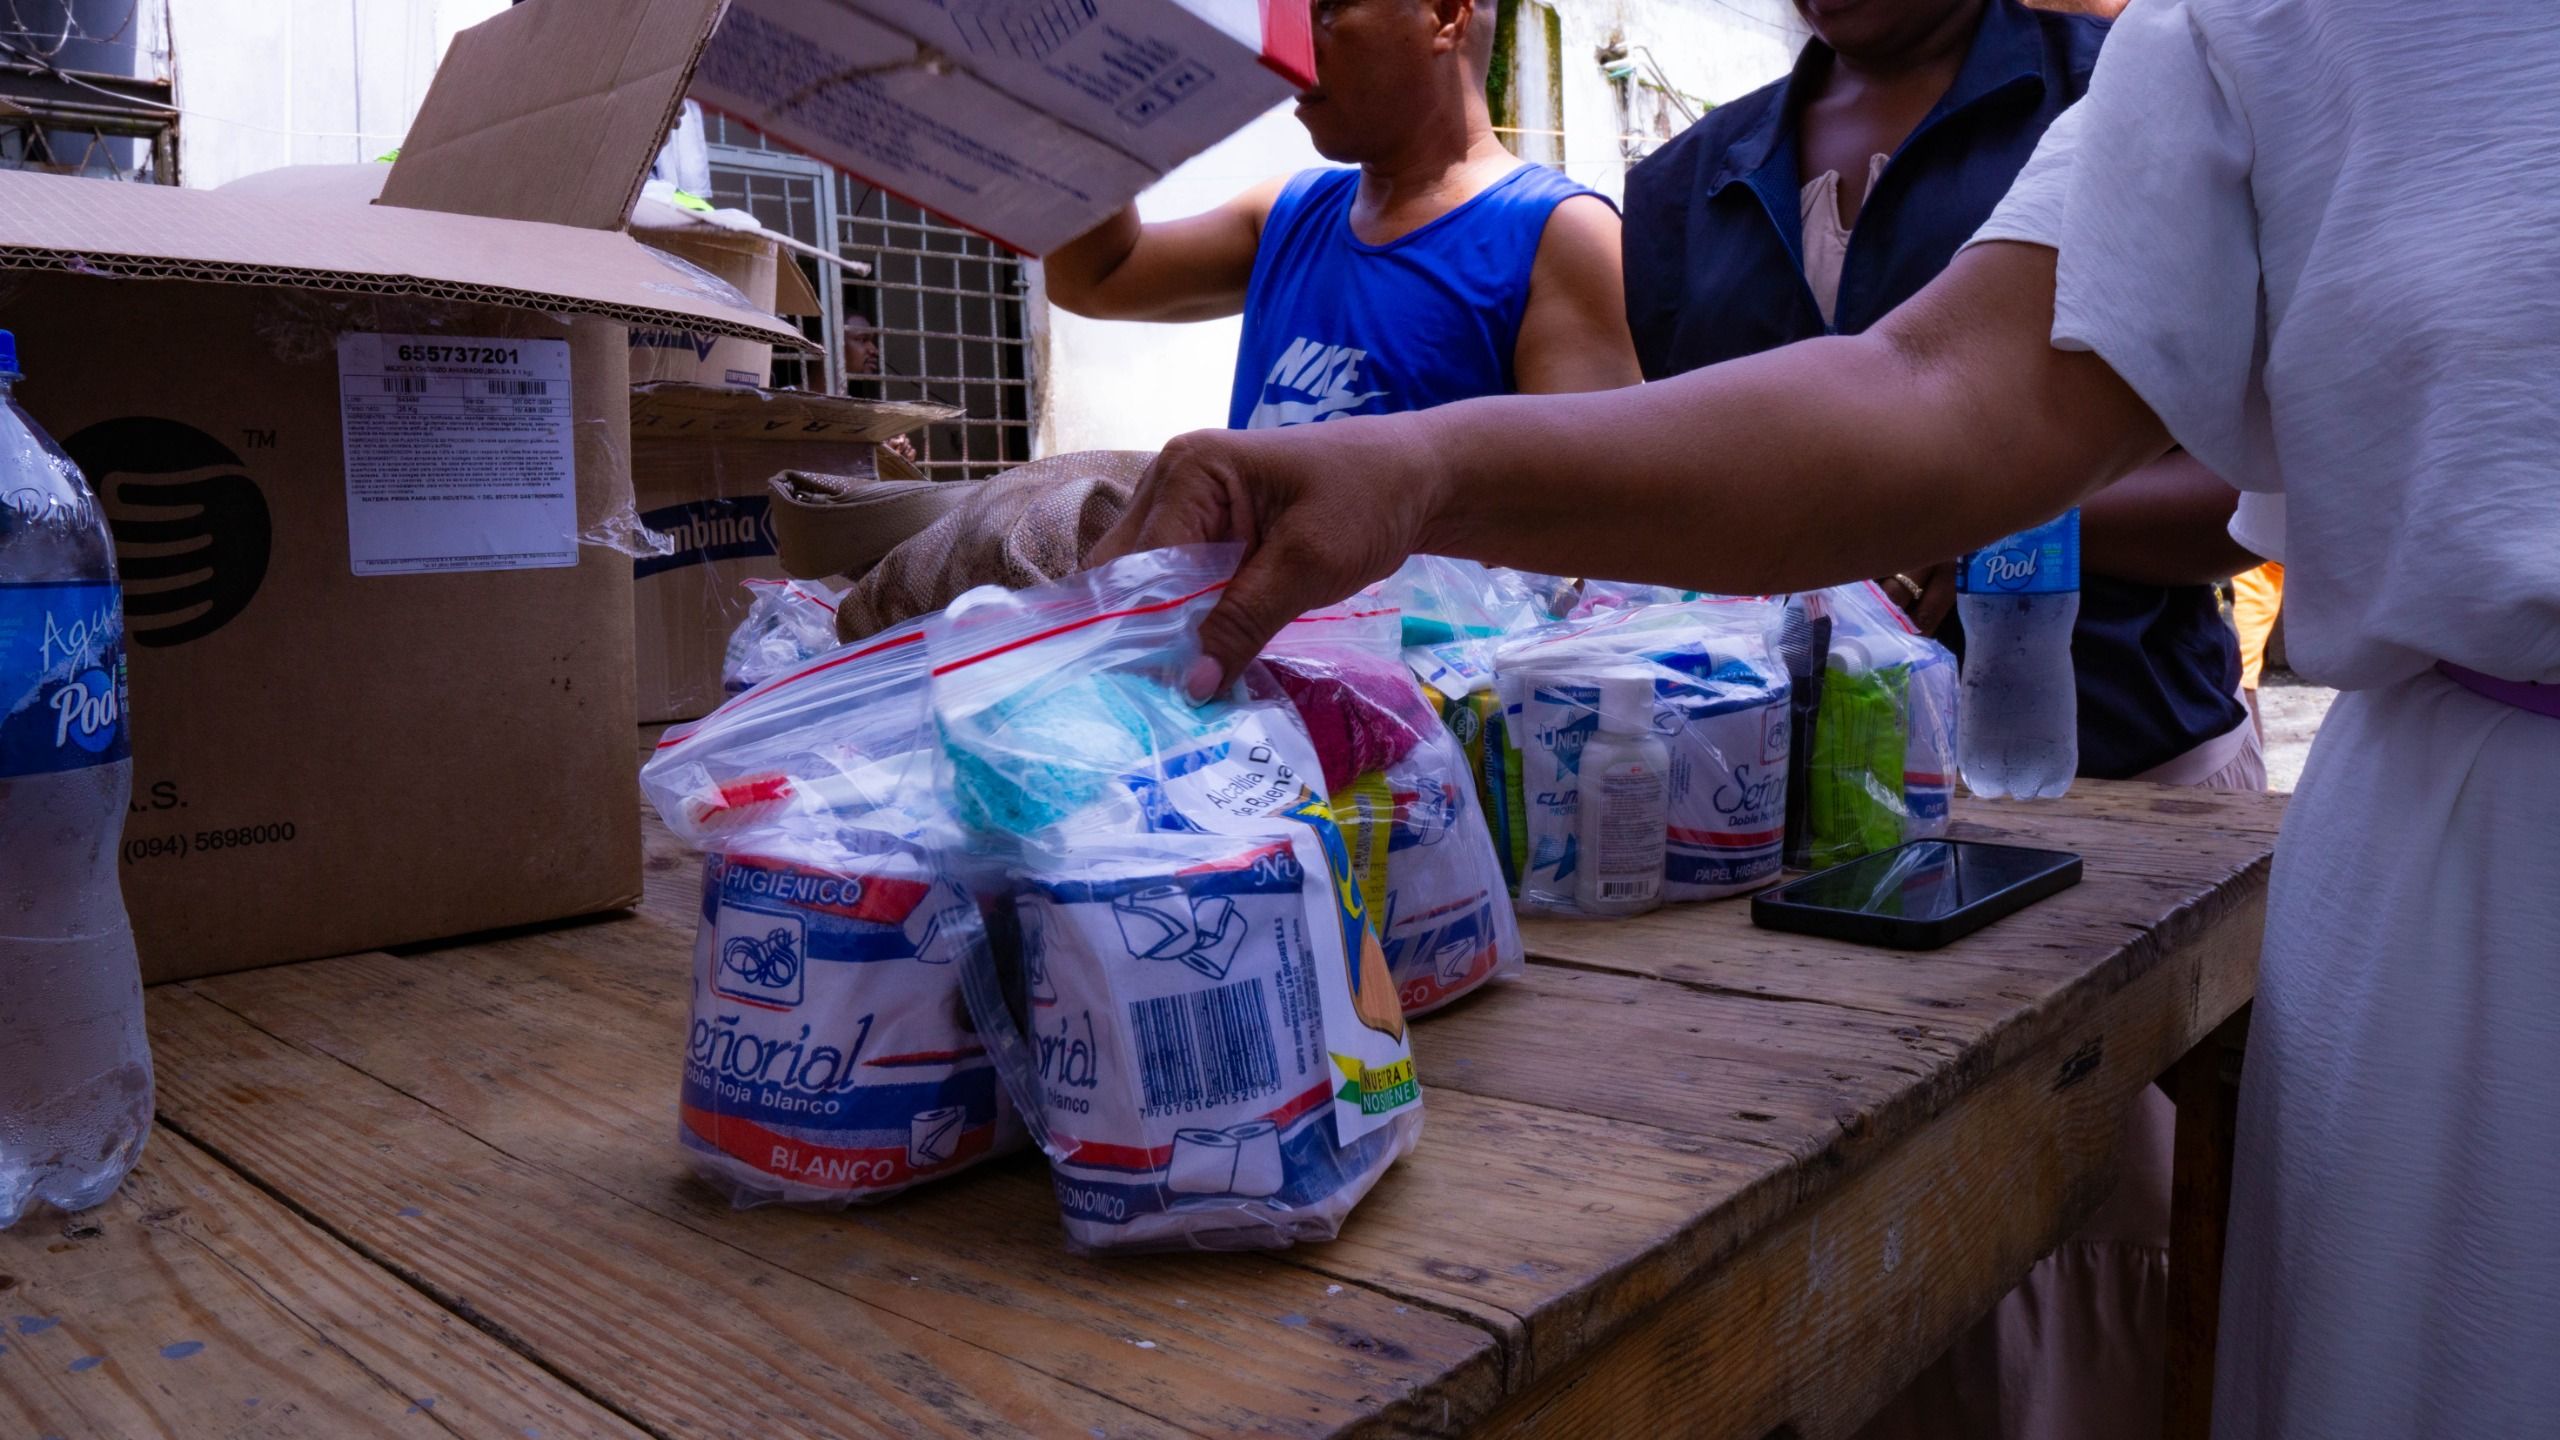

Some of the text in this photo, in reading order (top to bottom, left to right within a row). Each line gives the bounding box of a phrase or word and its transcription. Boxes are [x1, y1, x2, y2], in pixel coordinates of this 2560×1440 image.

[398, 344, 519, 364] 655737201
[1265, 336, 1367, 398] NIKE
[242, 428, 277, 449] TM
[1985, 547, 2038, 584] Pool
[50, 663, 119, 748] Pool
[1245, 761, 1294, 808] Buena
[124, 821, 296, 865] (094) 5698000
[1695, 868, 1732, 881] PAPEL
[687, 1012, 874, 1090] eñorial
[687, 1063, 841, 1115] oble hoja blanco
[770, 1144, 895, 1182] BLANCO
